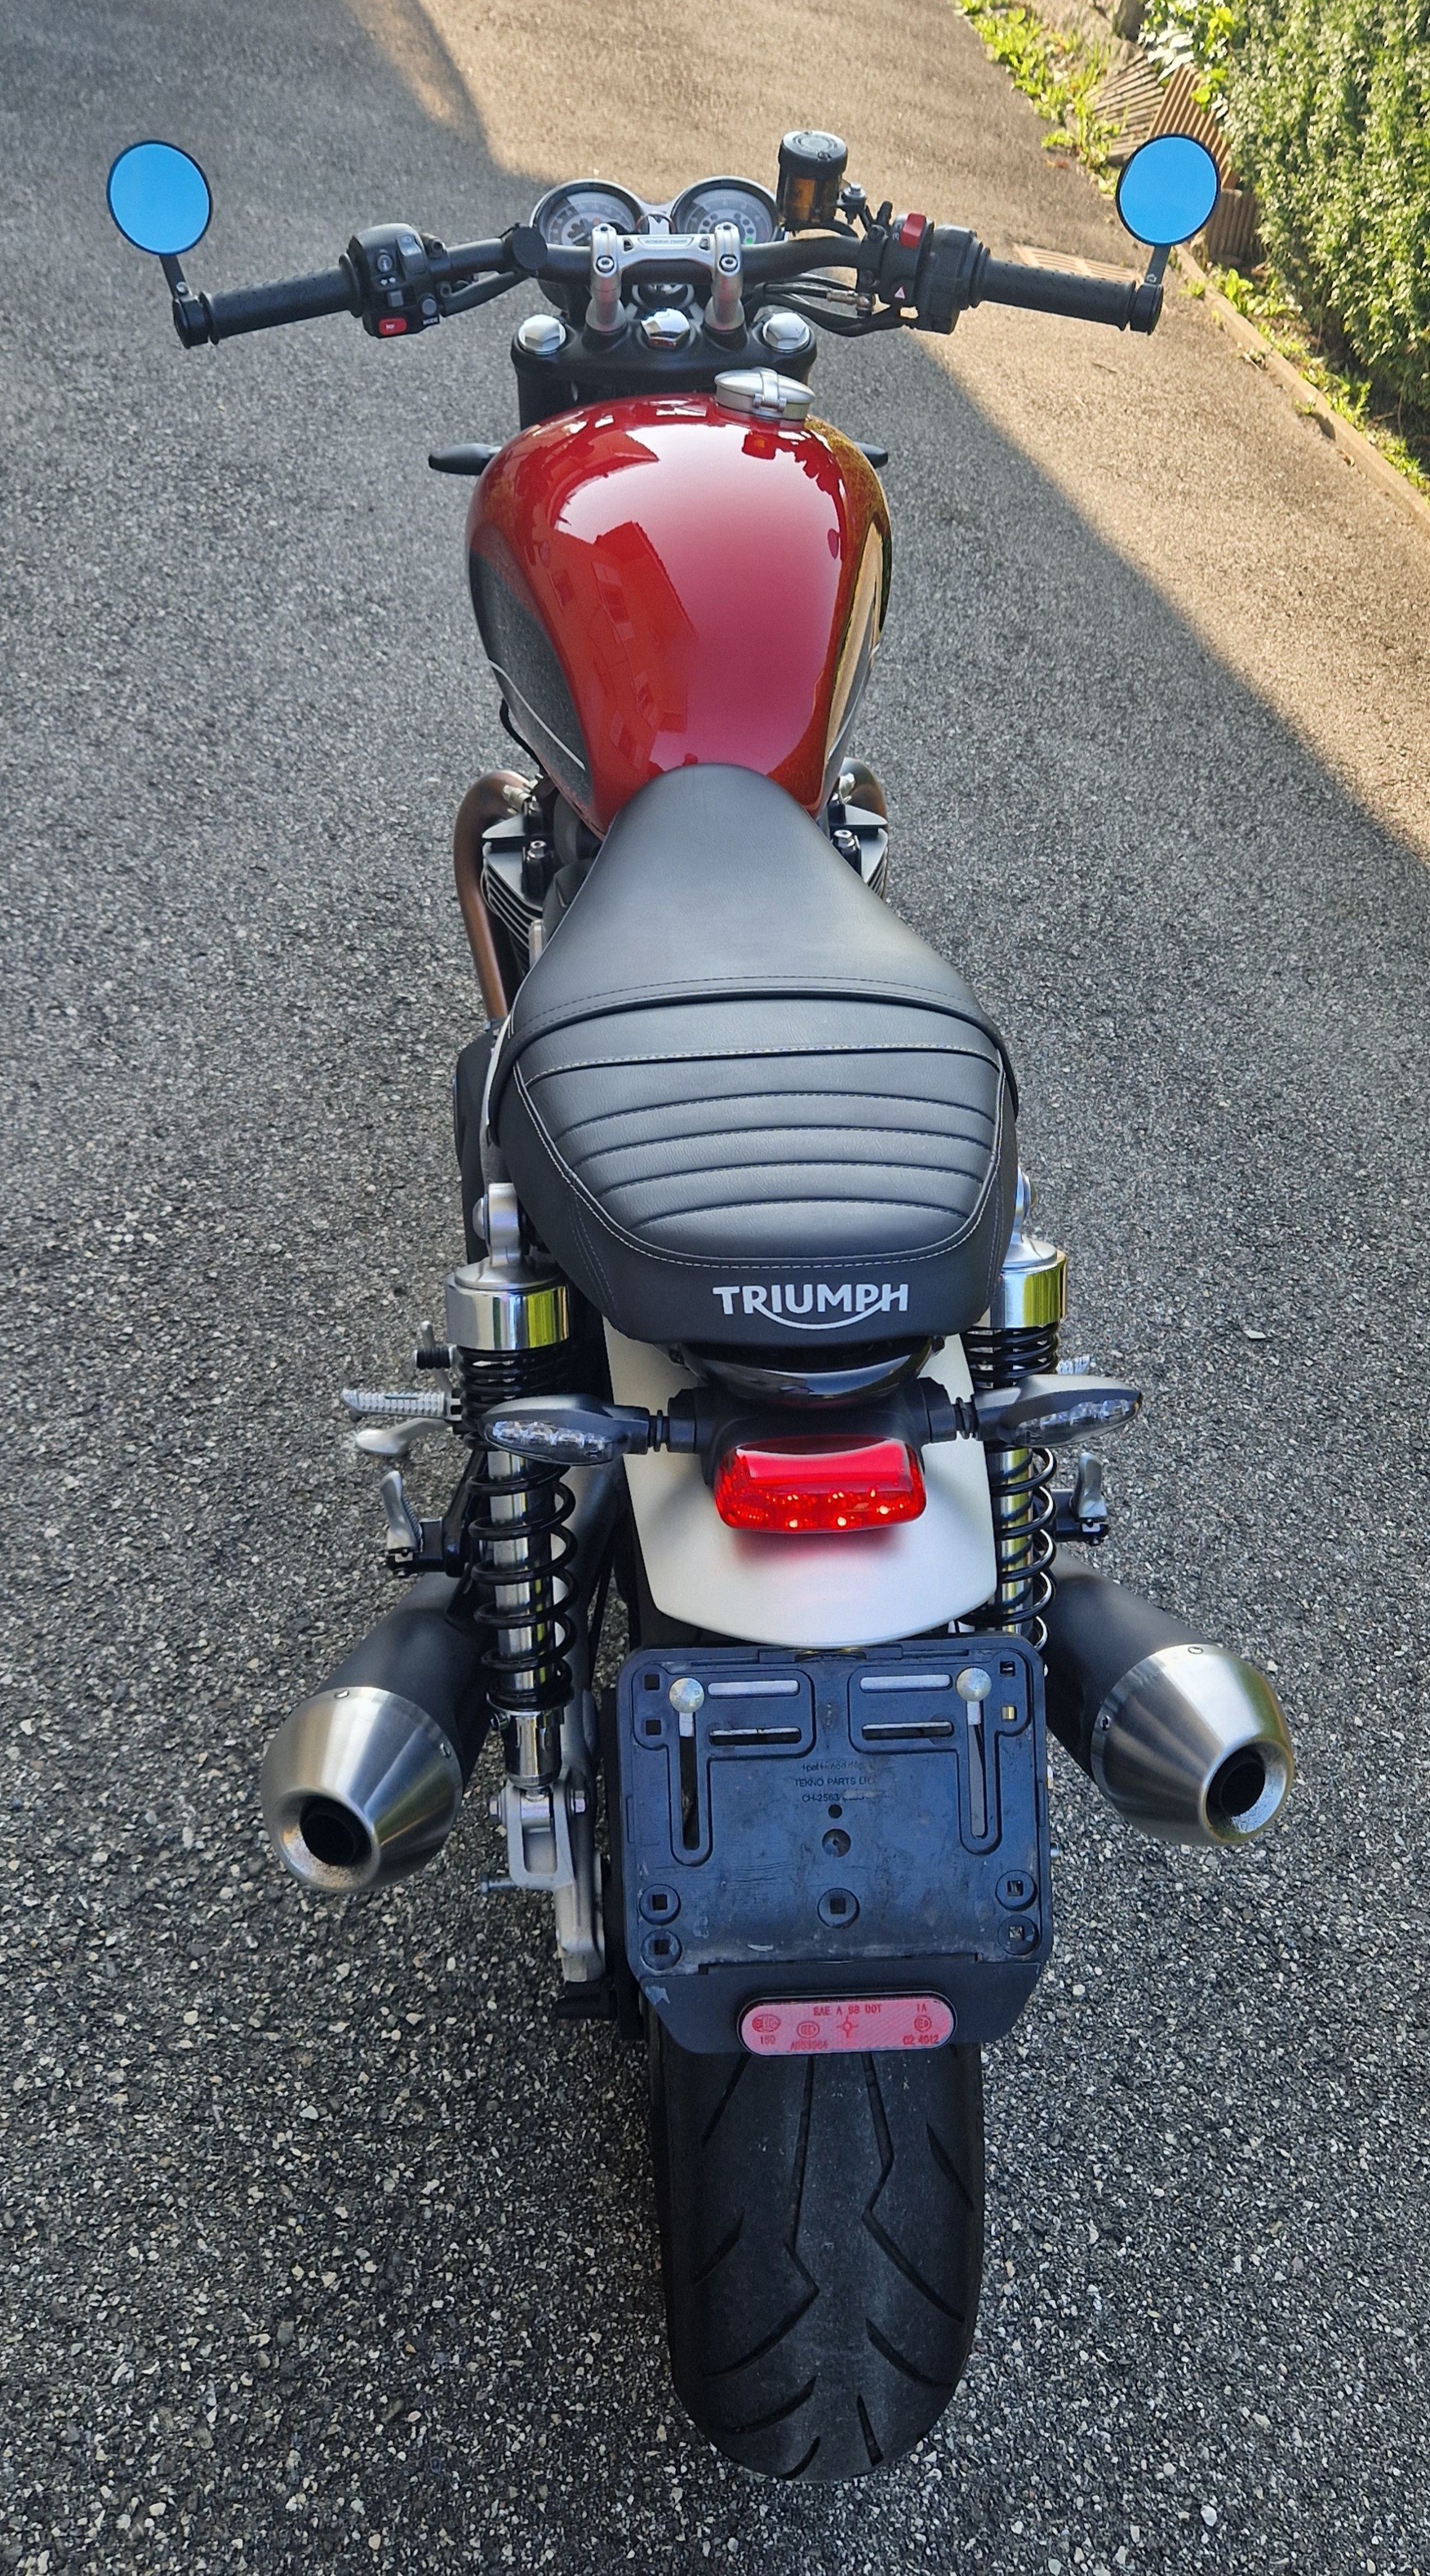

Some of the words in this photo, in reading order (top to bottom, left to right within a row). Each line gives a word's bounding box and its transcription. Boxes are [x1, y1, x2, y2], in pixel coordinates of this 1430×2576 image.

[712, 1284, 908, 1330] TRIUMPH
[795, 1777, 824, 1787] TEKNO
[827, 1776, 856, 1785] PARTS
[813, 2006, 831, 2015] SAE
[836, 2005, 843, 2015] A
[865, 2003, 882, 2015] DOT
